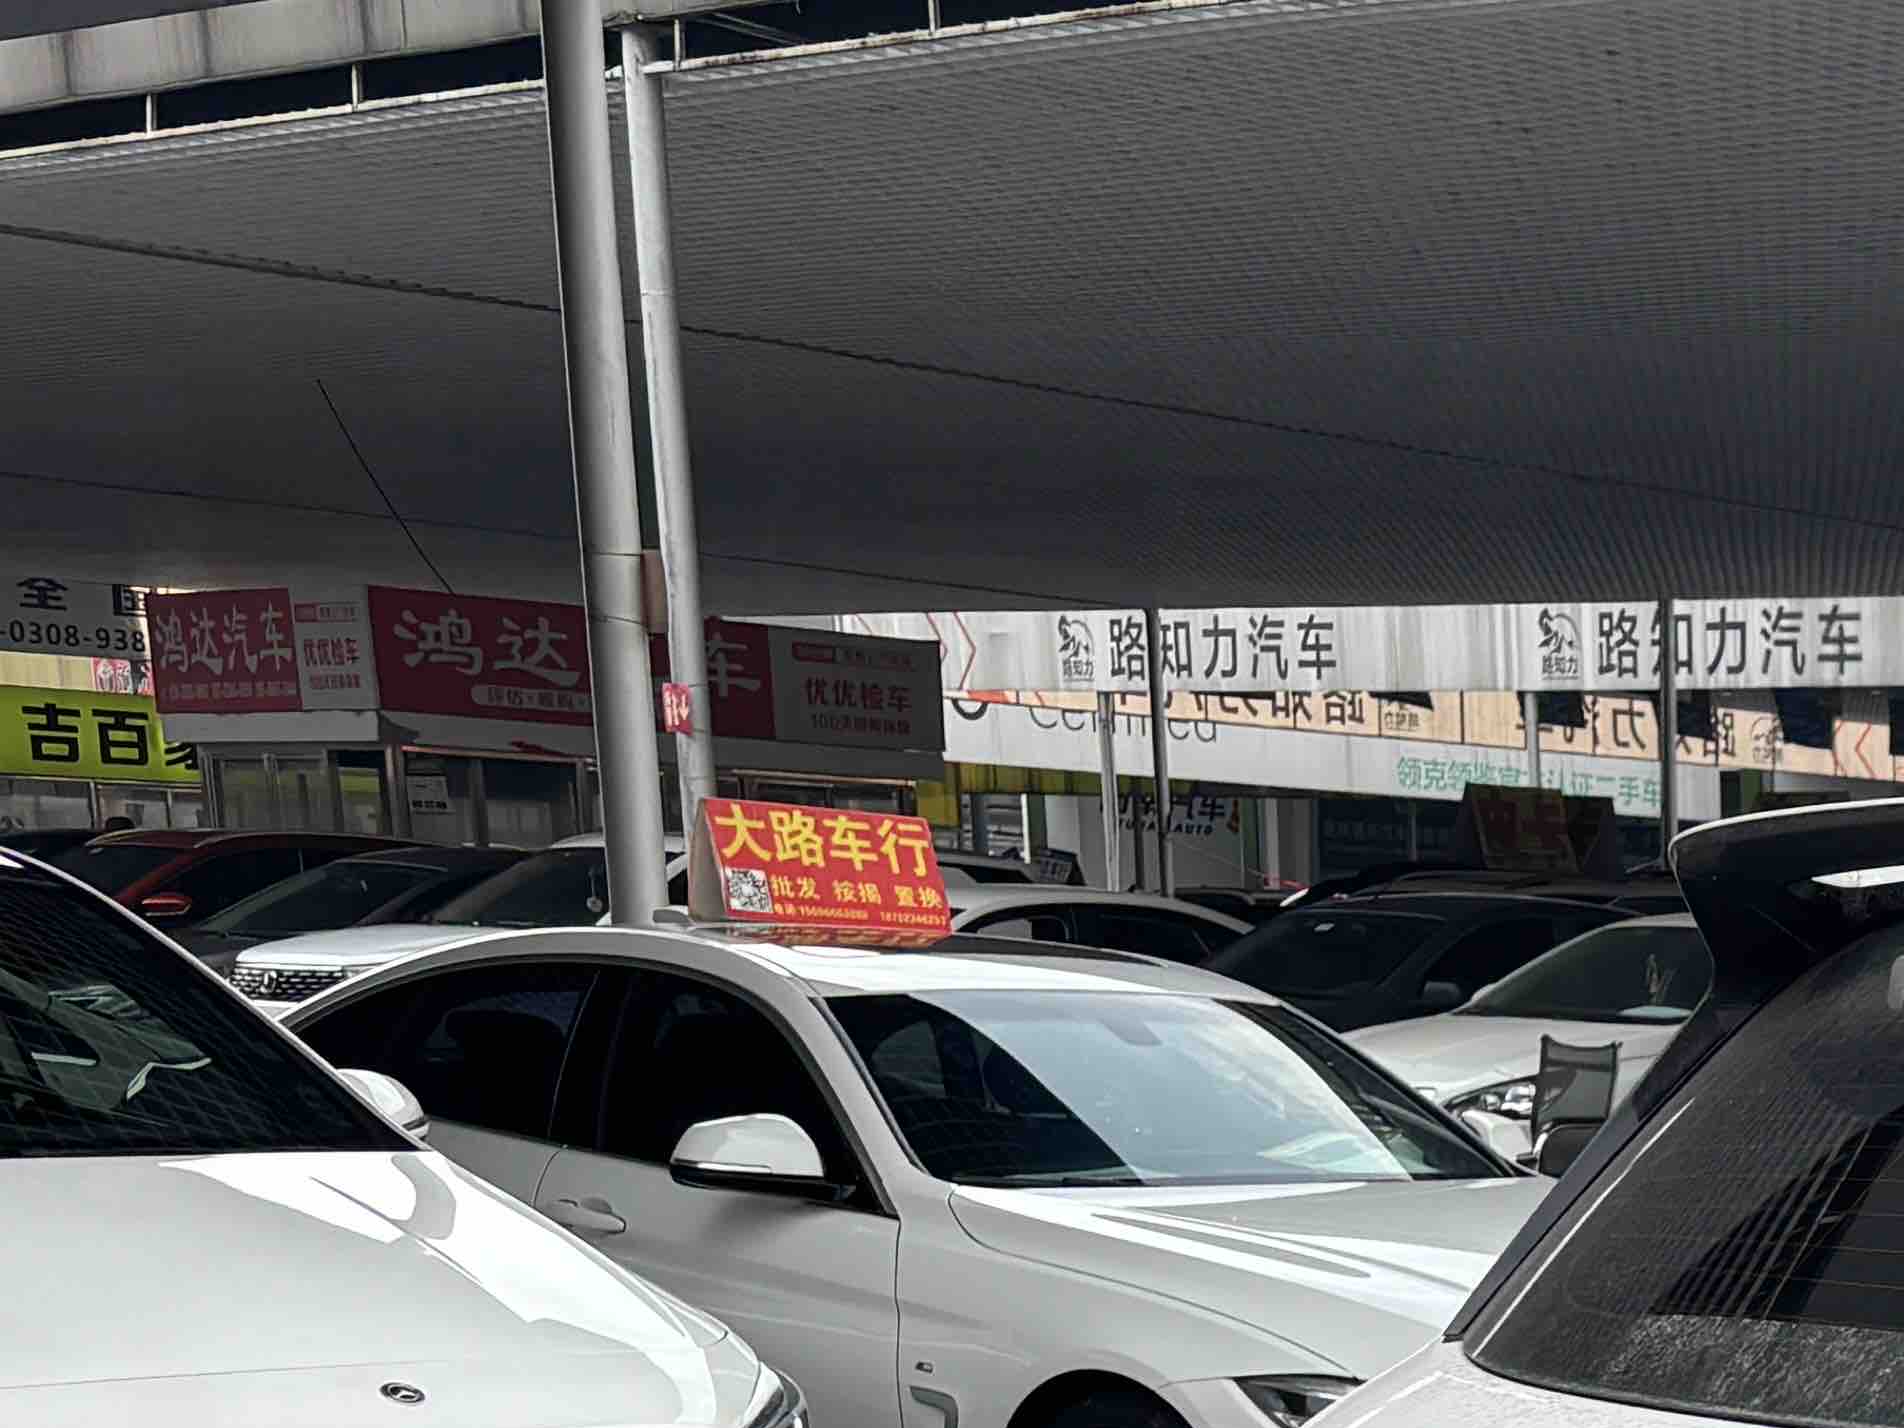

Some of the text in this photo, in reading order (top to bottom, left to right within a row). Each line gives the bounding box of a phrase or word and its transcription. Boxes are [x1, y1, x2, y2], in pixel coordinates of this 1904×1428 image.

[154, 600, 293, 675] 鸿达汽车
[1109, 614, 1337, 682] 路知力汽车
[1598, 606, 1863, 679] 路知力汽车
[715, 803, 931, 877] 大路车行
[771, 875, 821, 900] 批发
